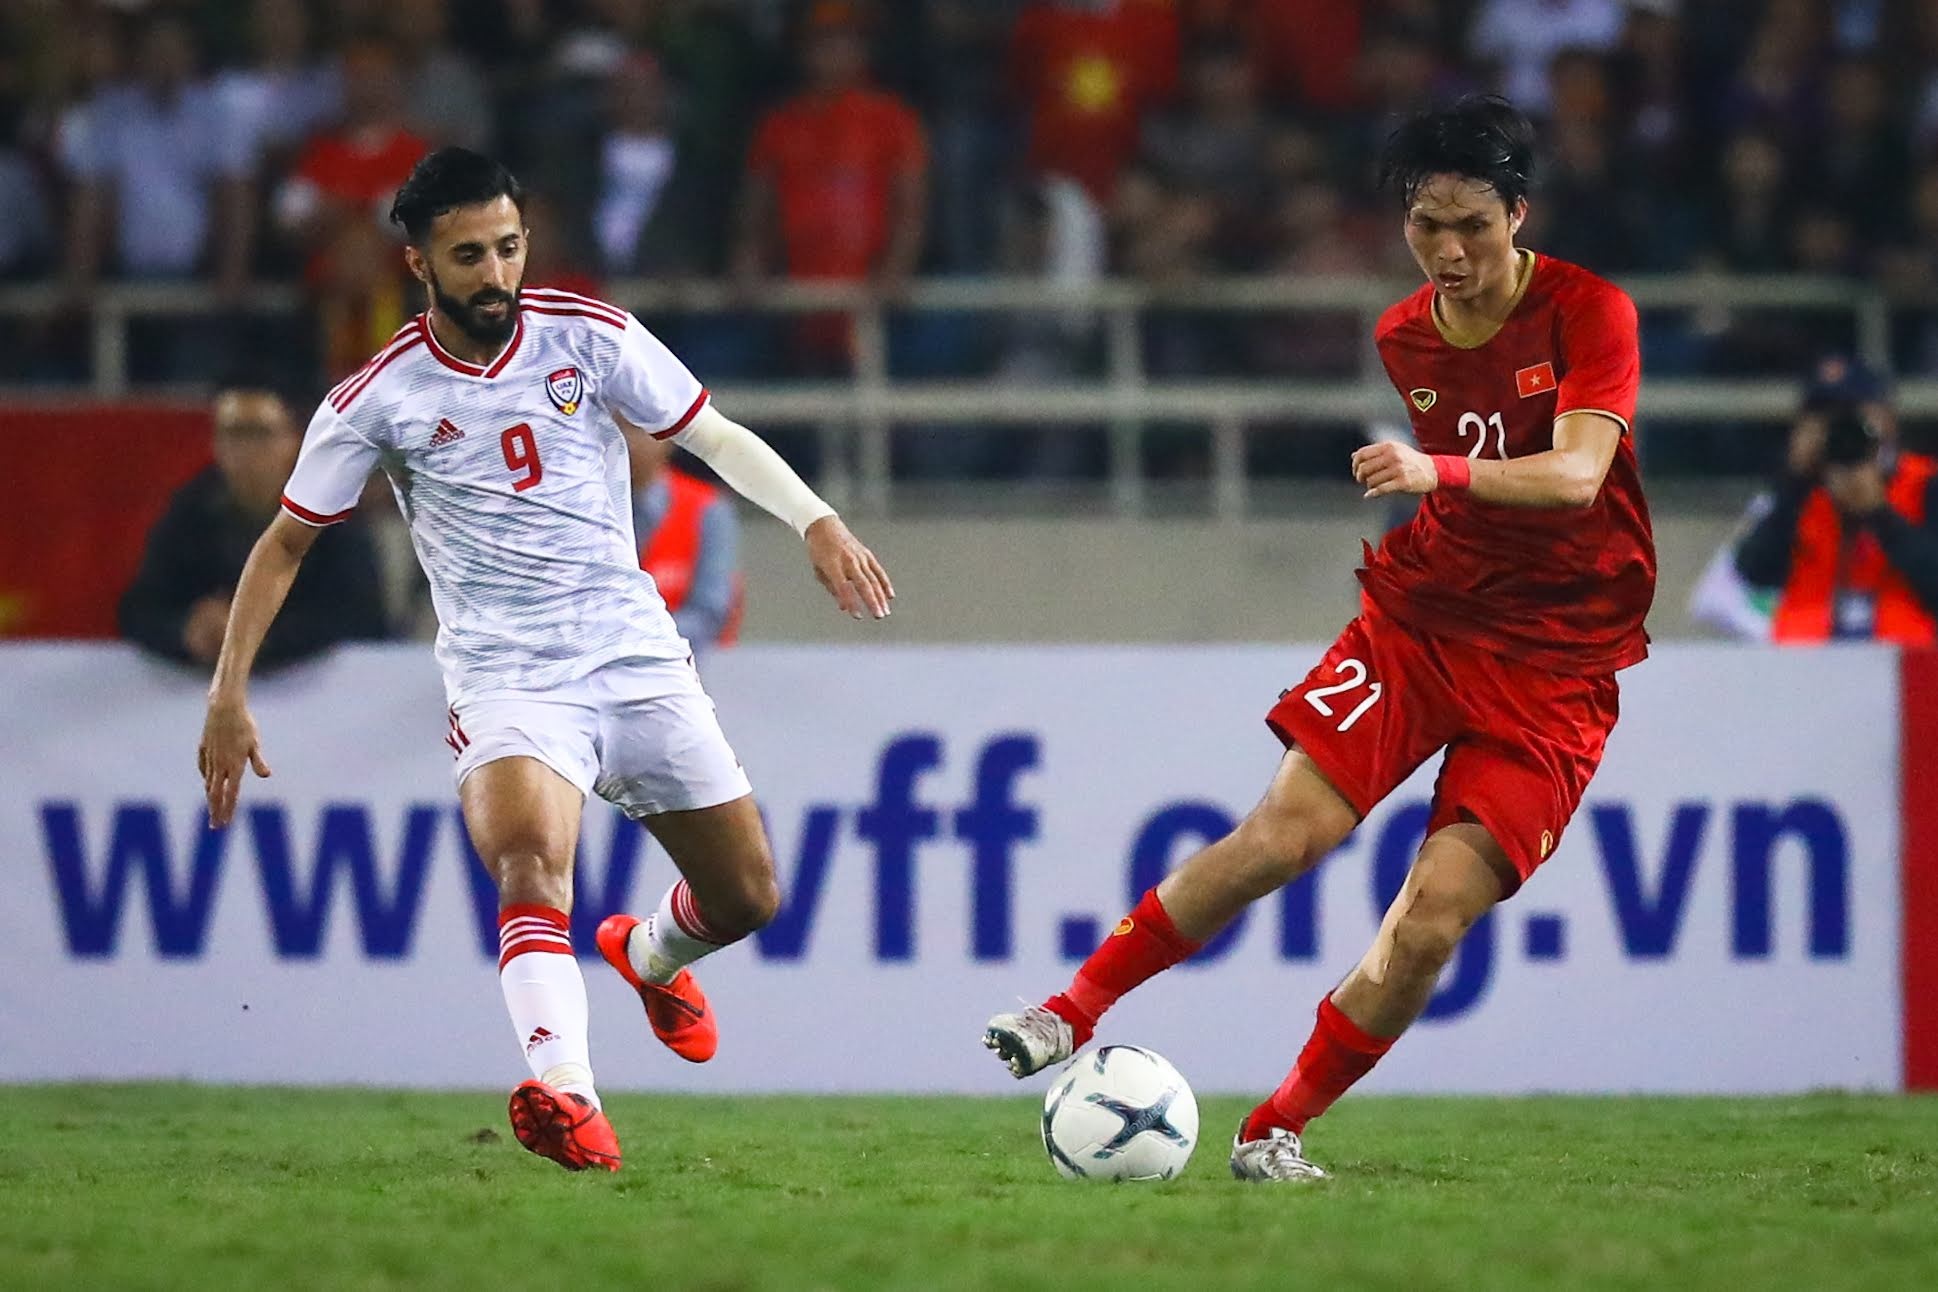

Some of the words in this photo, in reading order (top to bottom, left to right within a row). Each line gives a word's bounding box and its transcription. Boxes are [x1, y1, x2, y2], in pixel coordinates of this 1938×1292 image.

[429, 430, 465, 447] adidas
[501, 423, 541, 492] 9
[1458, 412, 1508, 460] 21
[1304, 659, 1381, 731] 21
